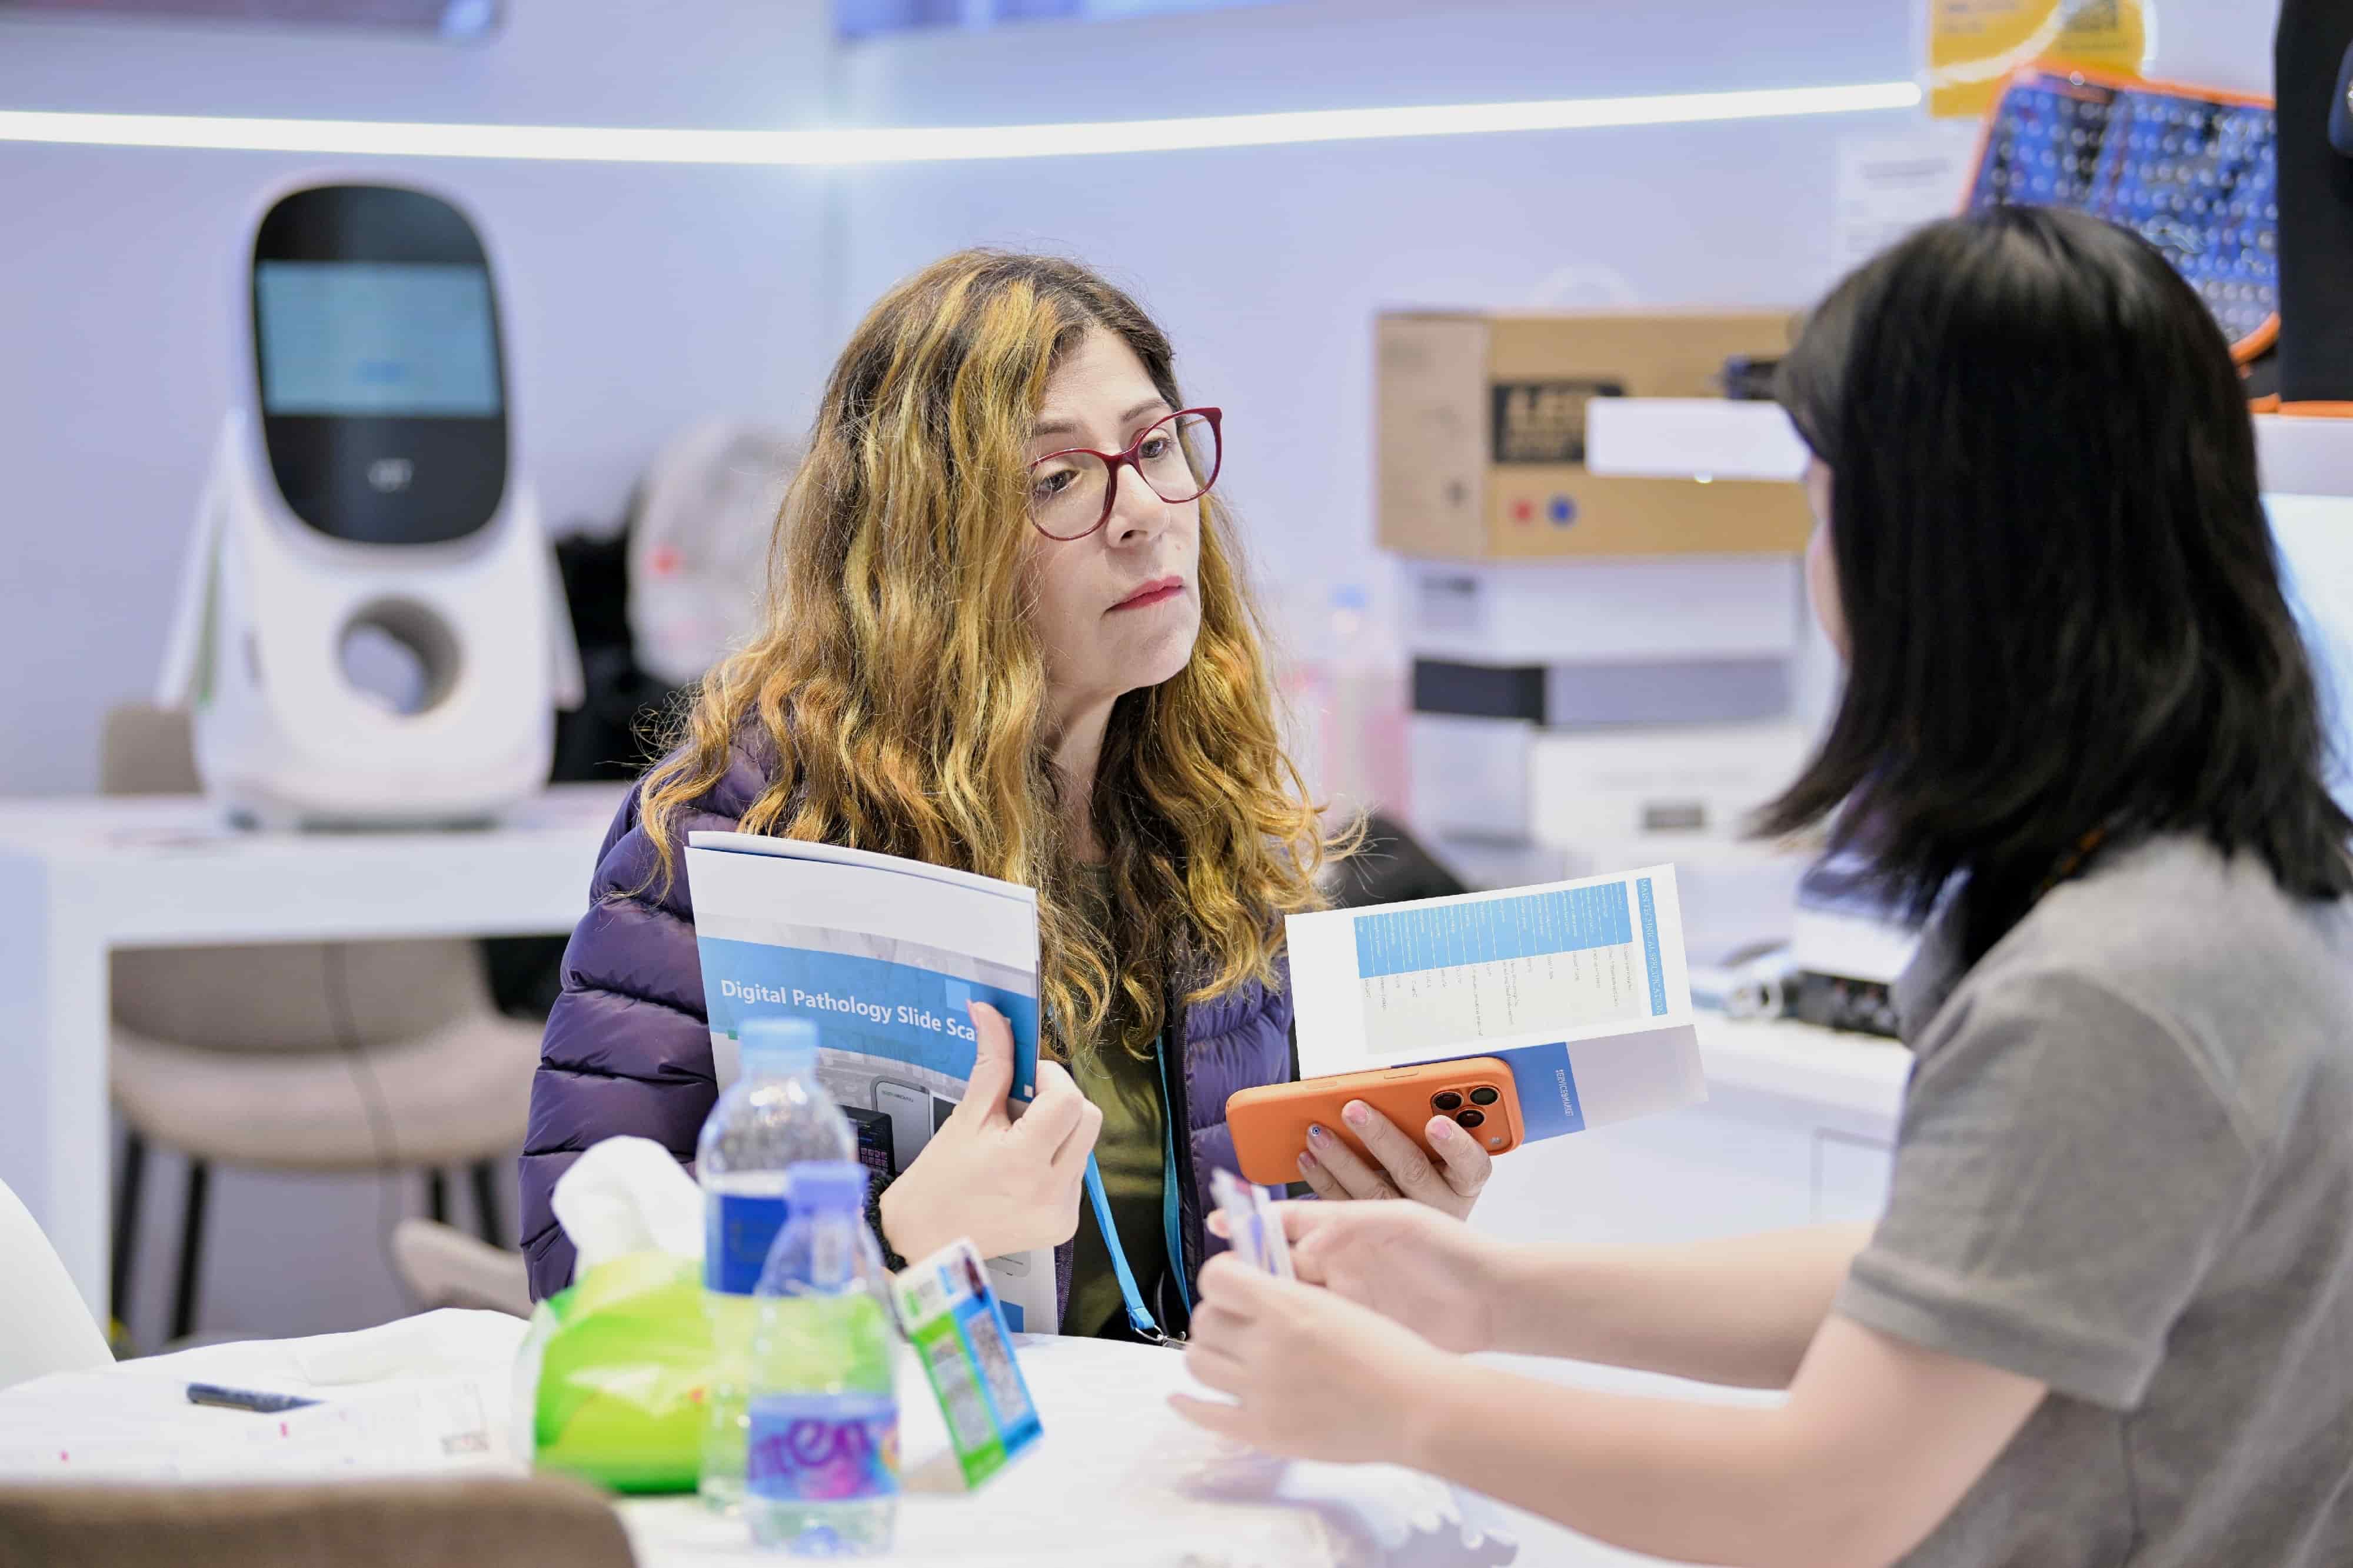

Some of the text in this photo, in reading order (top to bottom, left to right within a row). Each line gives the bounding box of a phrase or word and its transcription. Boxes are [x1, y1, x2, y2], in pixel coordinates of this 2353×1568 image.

[721, 979, 977, 1041] Digital Pathology Slide Sca
